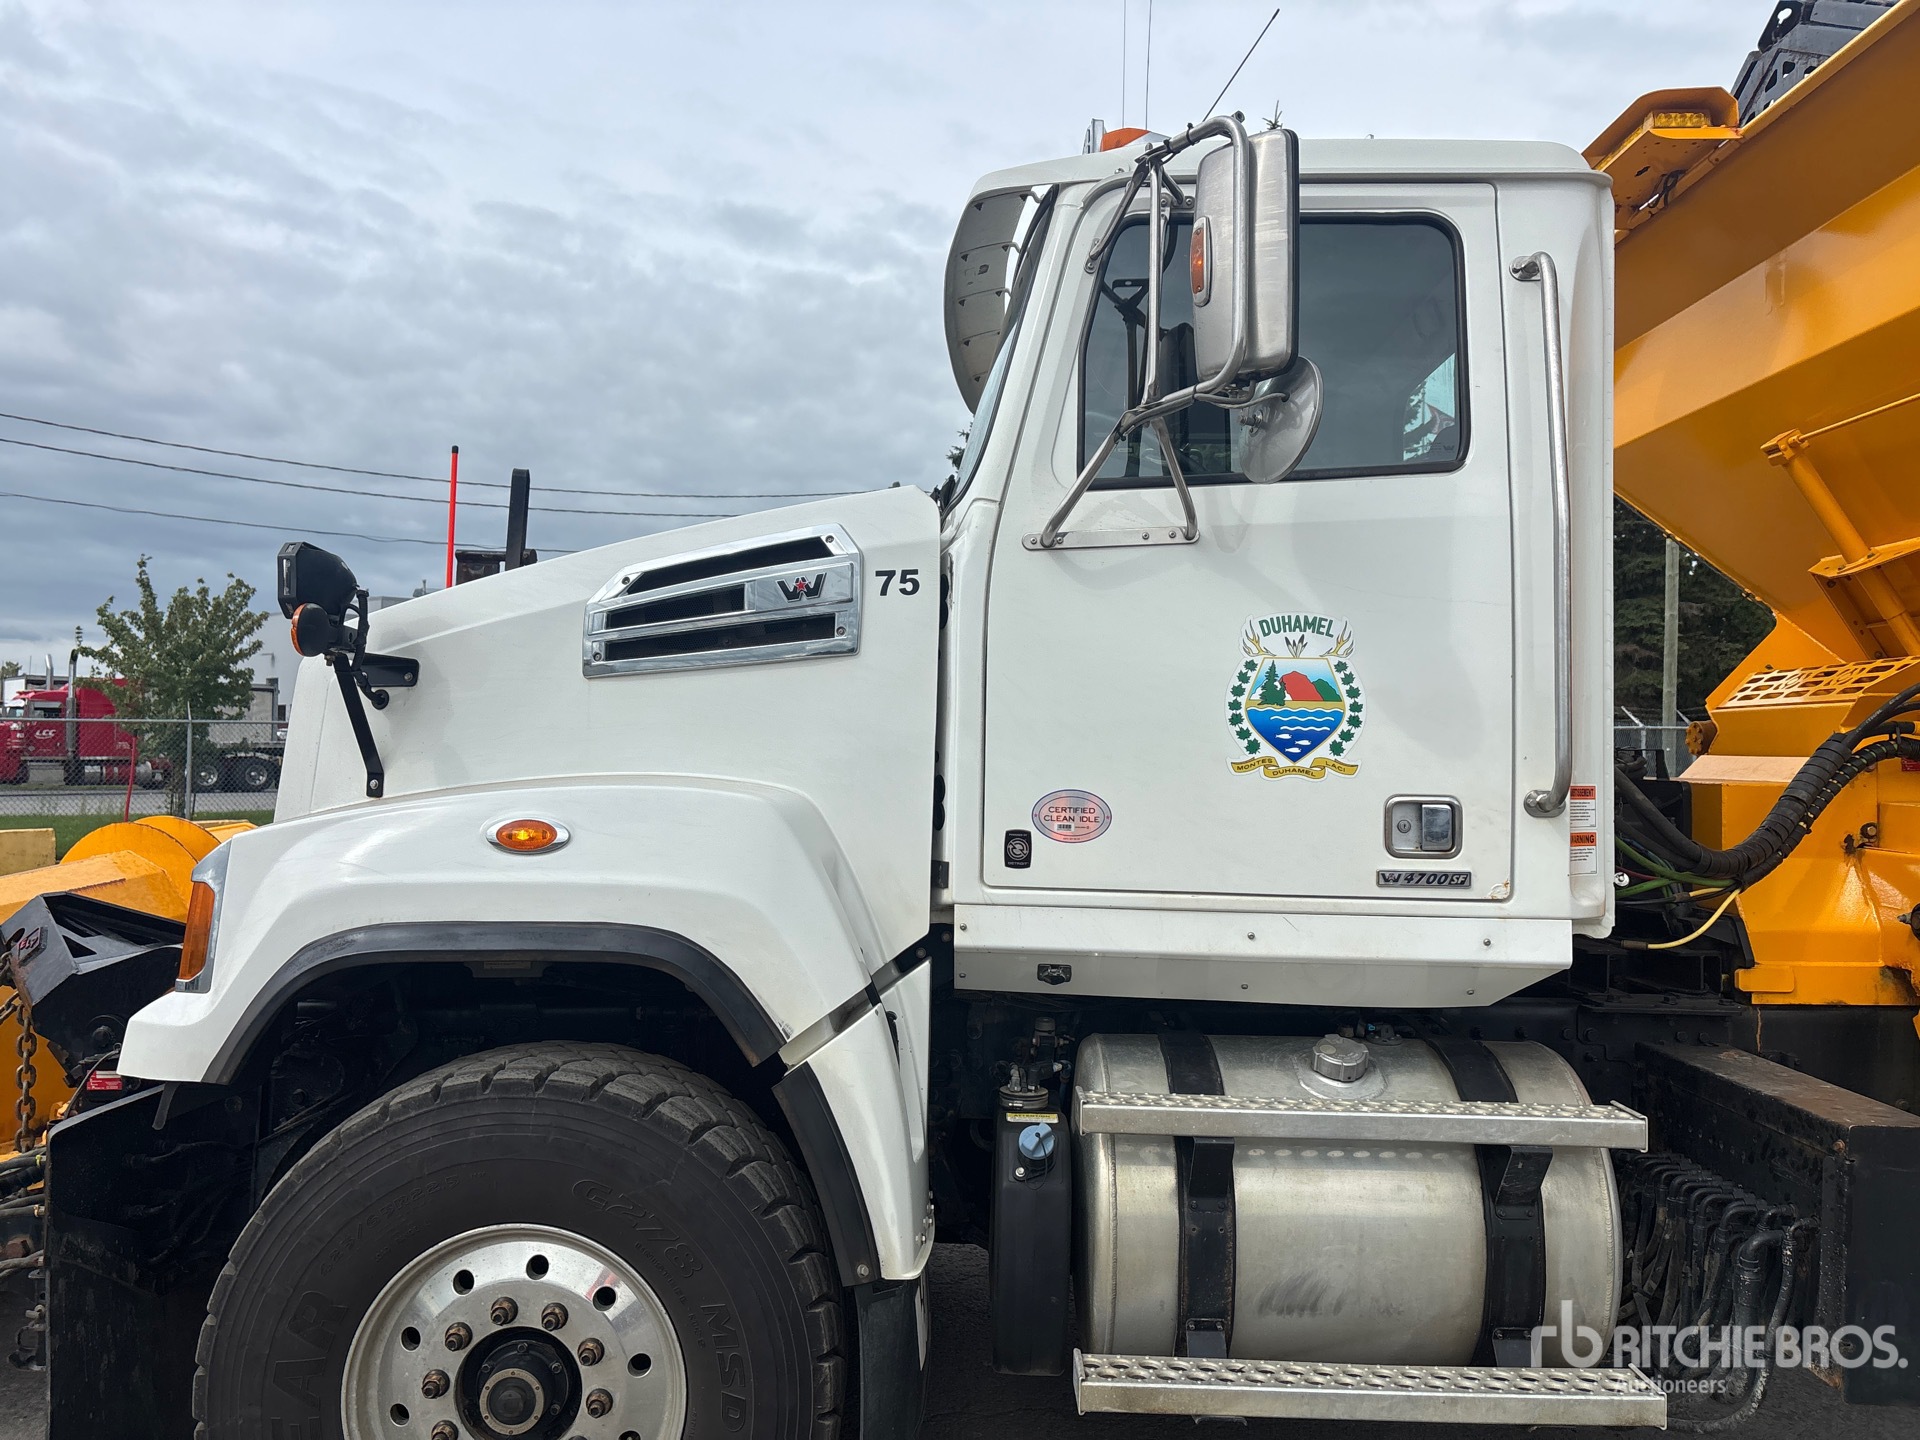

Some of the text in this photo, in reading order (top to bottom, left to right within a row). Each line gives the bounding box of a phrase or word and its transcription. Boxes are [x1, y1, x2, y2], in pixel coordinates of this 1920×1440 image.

[875, 568, 921, 597] 75
[1258, 614, 1335, 638] DUHAMEL
[1236, 758, 1346, 778] MONTES DUHAMEL LACI
[1043, 814, 1100, 823] CLEAN IDLE
[1048, 806, 1096, 814] CERTIFIED
[700, 1302, 747, 1432] MSD
